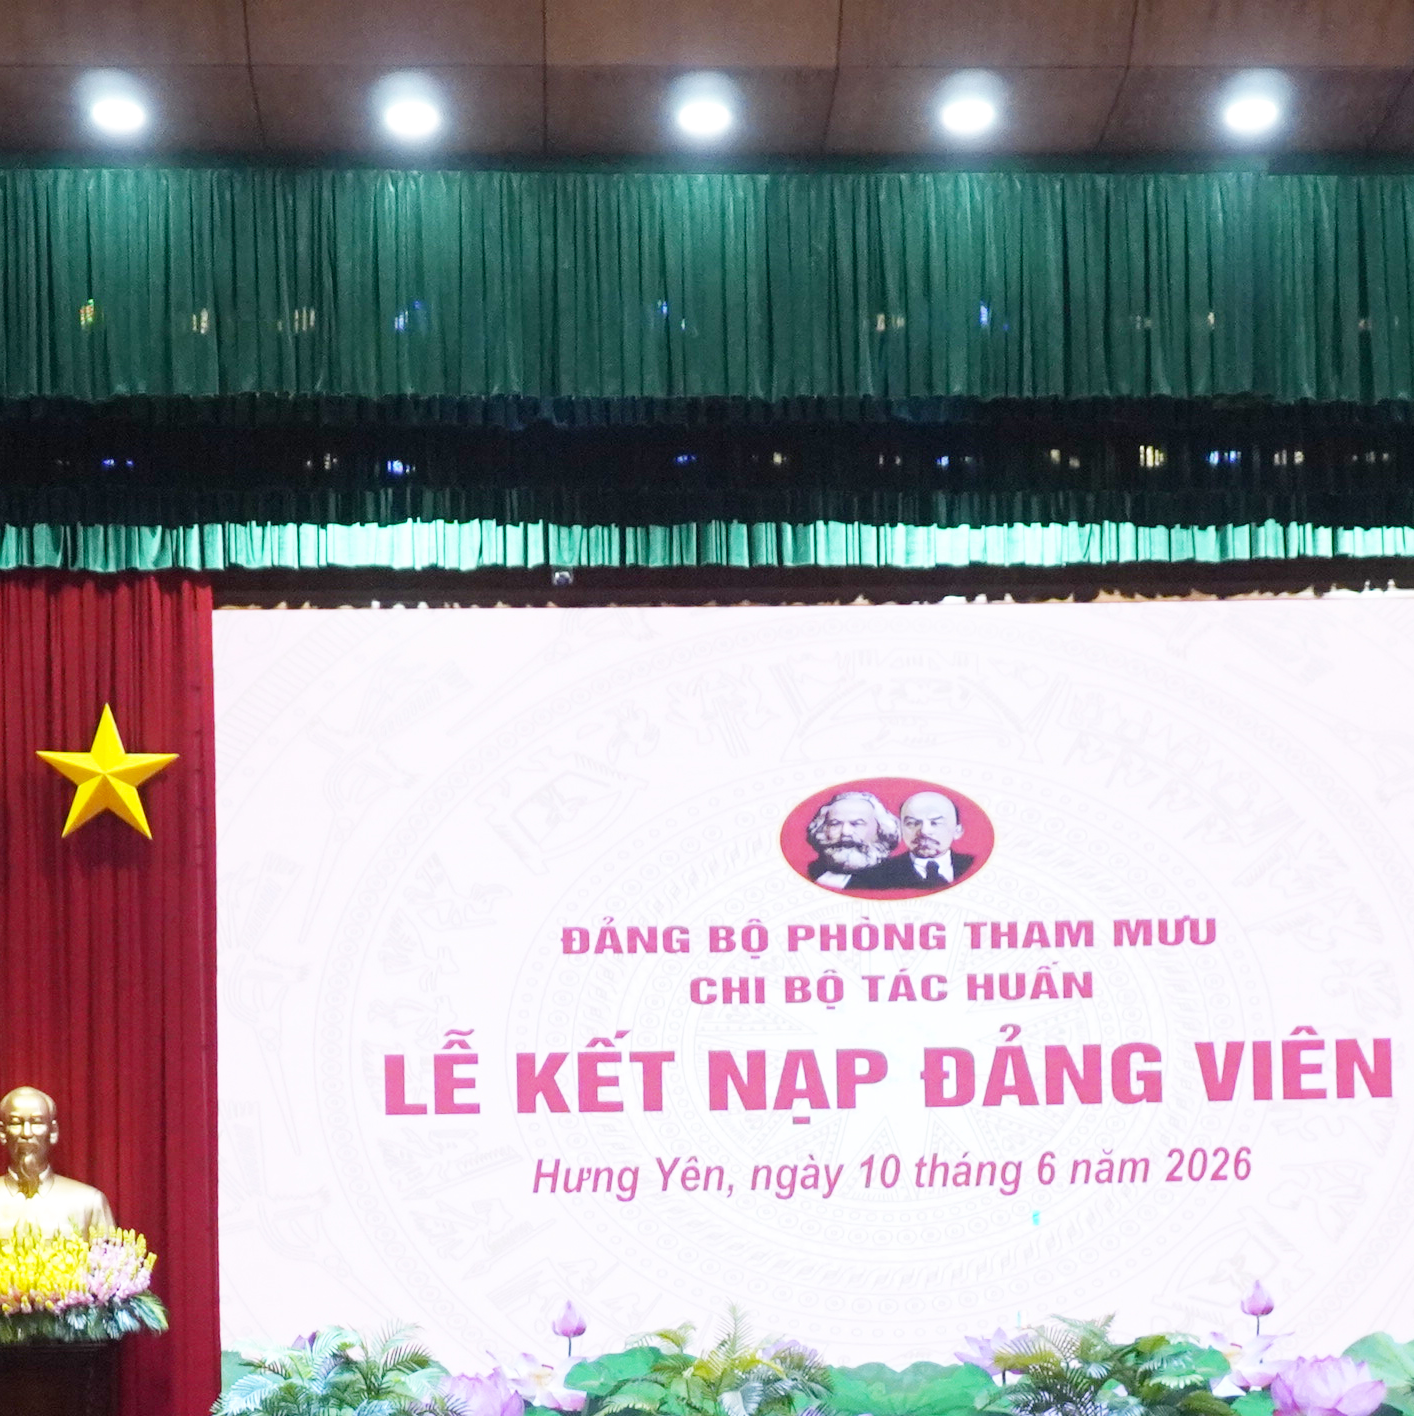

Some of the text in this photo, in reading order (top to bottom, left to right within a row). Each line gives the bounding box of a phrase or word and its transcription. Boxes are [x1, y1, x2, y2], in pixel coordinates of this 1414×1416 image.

[561, 915, 1217, 960] ĐẢNG BỘ PHÒNG THAM MƯU
[689, 961, 1094, 1010] CHI BỘ TÁC HUẤN
[386, 1024, 1394, 1126] LỄ KẾT NẠP ĐẢNG VIÊN
[532, 1146, 1254, 1203] Hưng Yên, ngày 10 tháng 6 năm 2026
